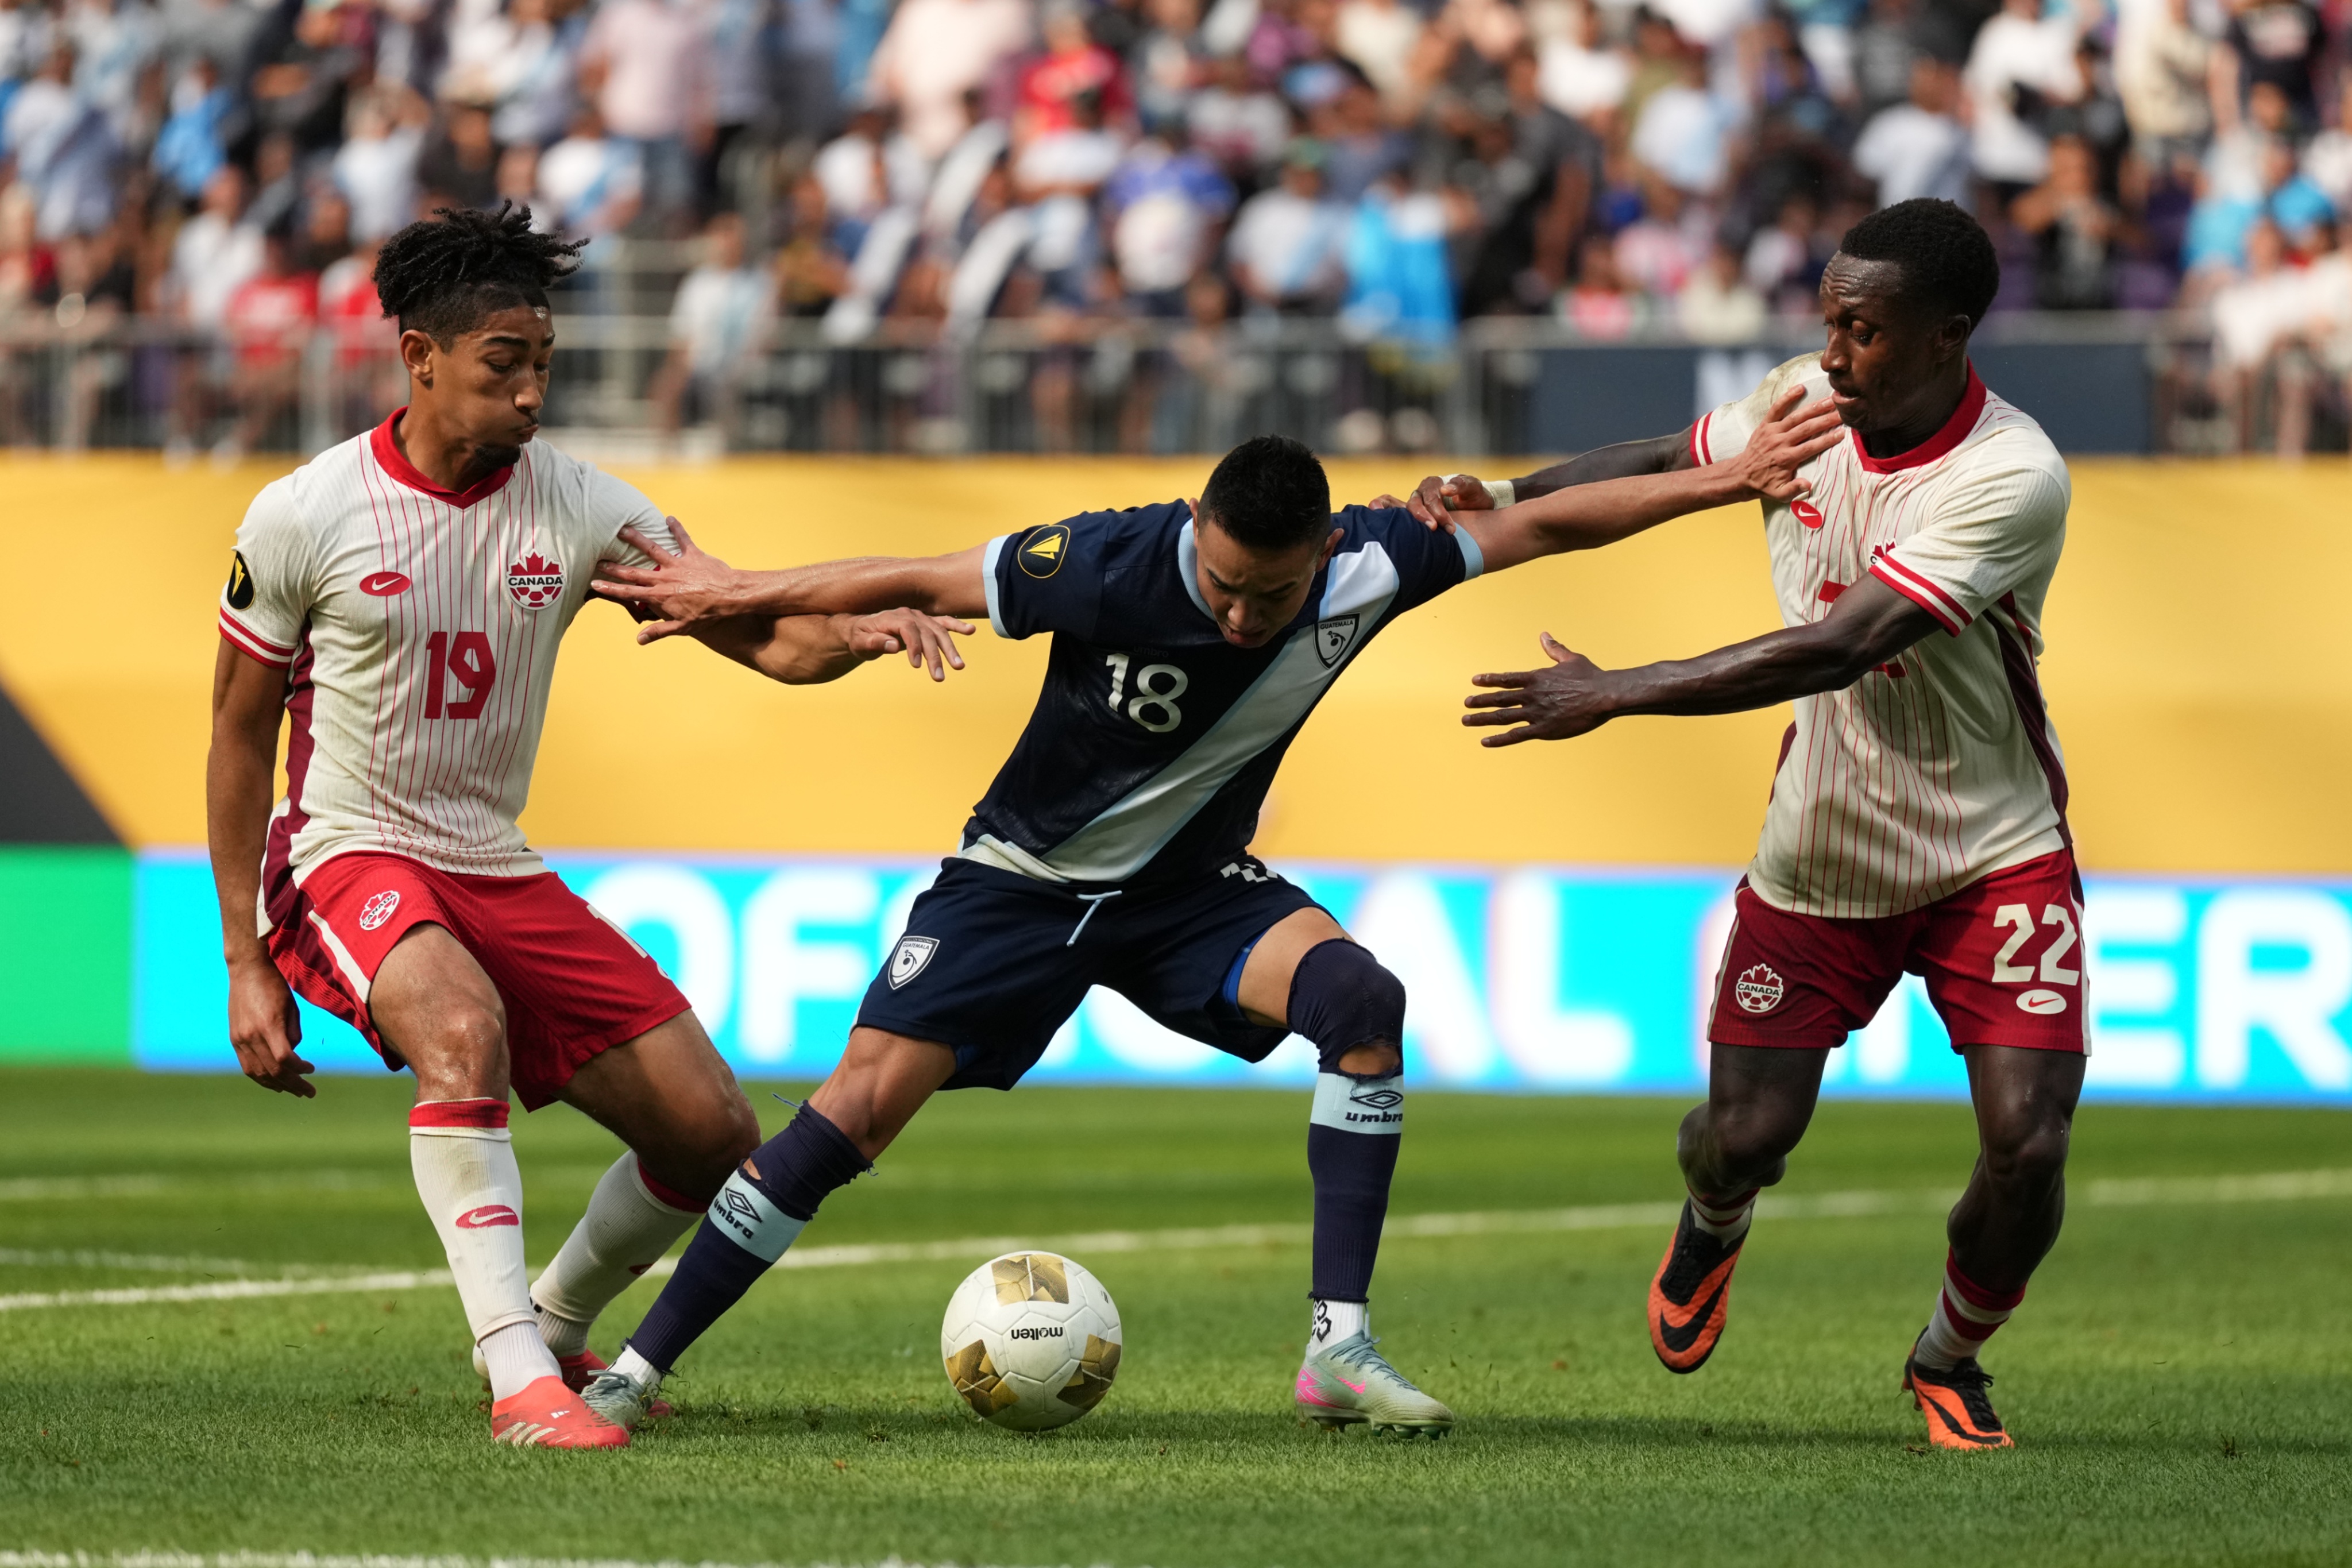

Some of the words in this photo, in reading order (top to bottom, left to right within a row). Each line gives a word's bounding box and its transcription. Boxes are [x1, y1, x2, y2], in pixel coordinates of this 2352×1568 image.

[508, 577, 563, 586] CANADA
[1320, 620, 1354, 629] GUATEMALA
[1133, 645, 1169, 658] umbro
[424, 631, 496, 720] 19
[1106, 652, 1188, 733] 18
[362, 894, 396, 926] CANADA
[1992, 903, 2080, 986] 22
[1737, 983, 1780, 997] CANADA
[714, 1198, 754, 1239] umbro
[1011, 1326, 1063, 1341] molten
